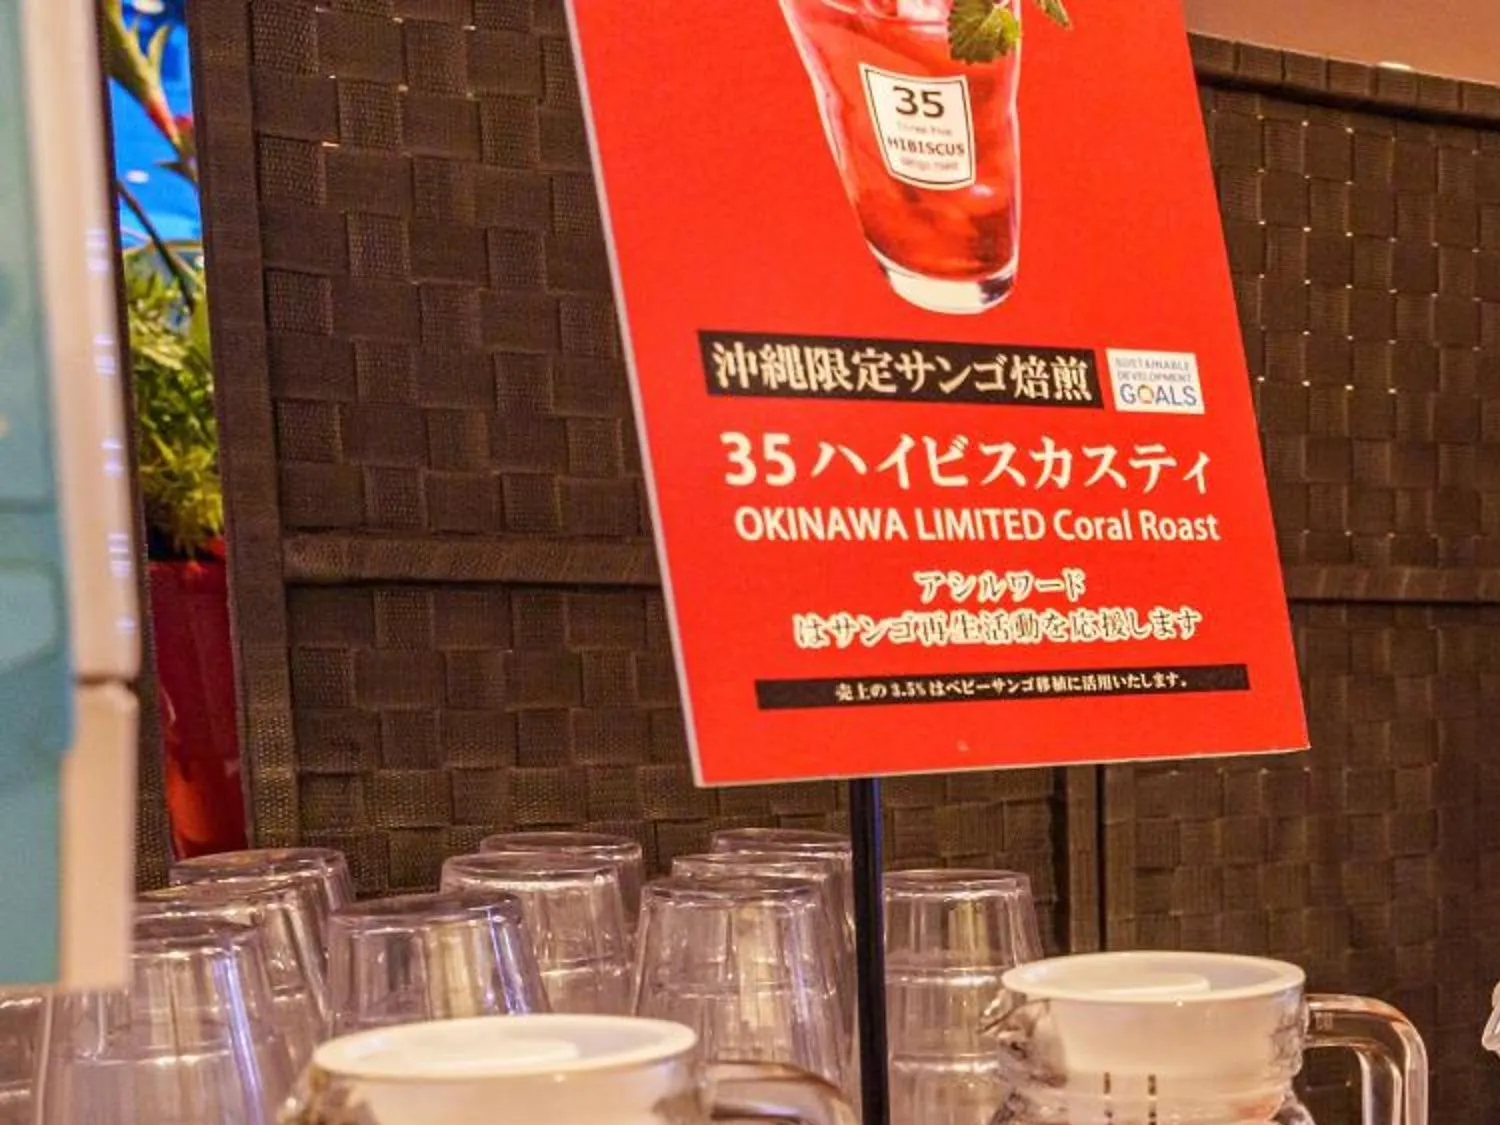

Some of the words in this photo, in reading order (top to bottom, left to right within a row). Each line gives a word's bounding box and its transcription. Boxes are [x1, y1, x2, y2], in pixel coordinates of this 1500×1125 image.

[892, 85, 945, 119] 35
[887, 136, 965, 157] HIBISCUS
[714, 341, 1093, 402] 沖縄限定サンゴ焙煎
[1119, 382, 1198, 408] GOALS
[734, 506, 909, 542] OKINAWA
[915, 507, 1046, 542] LIMITED
[1053, 507, 1132, 542] Coral
[1140, 510, 1221, 542] Roast
[914, 569, 1087, 603] アシルワード
[793, 609, 1203, 648] はサンゴ再生活動を応援します
